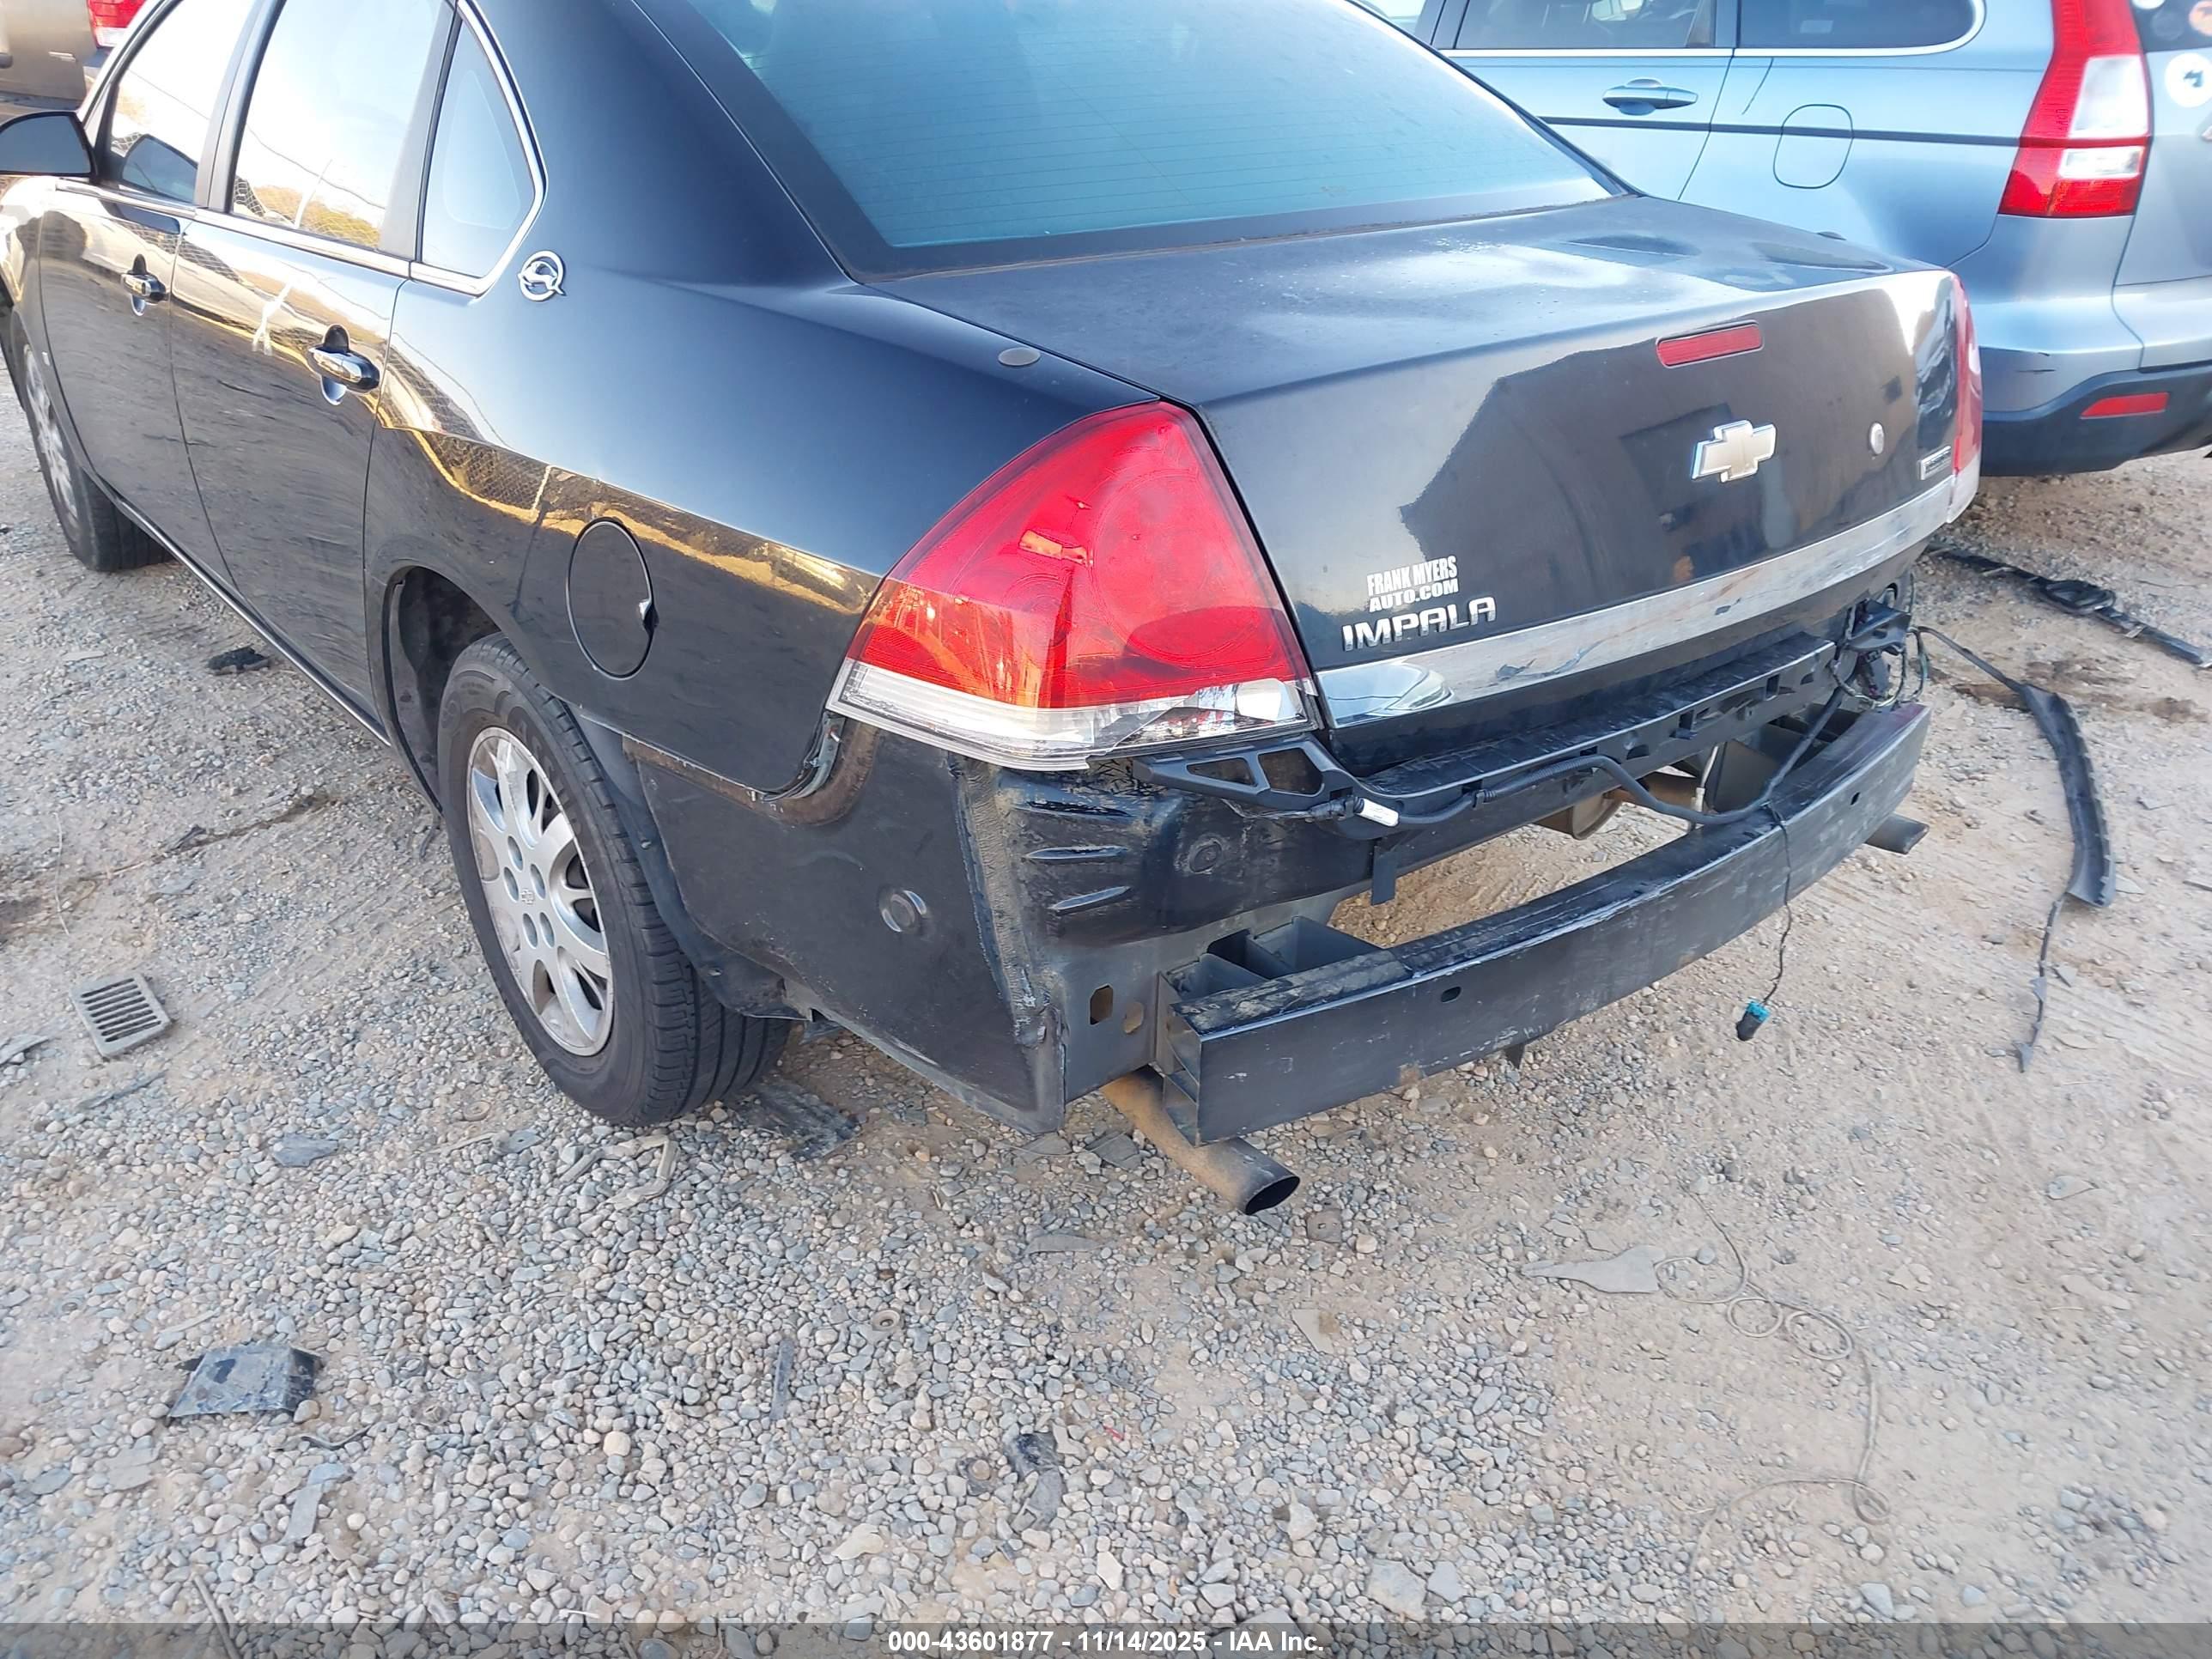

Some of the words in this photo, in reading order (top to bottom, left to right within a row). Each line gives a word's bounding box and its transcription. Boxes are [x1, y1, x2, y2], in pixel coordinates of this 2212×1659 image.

[1366, 565, 1412, 597] FRANK
[1413, 555, 1458, 585] MYERS
[1369, 578, 1459, 613] AUTO.COM
[1342, 596, 1497, 652] IMPALA
